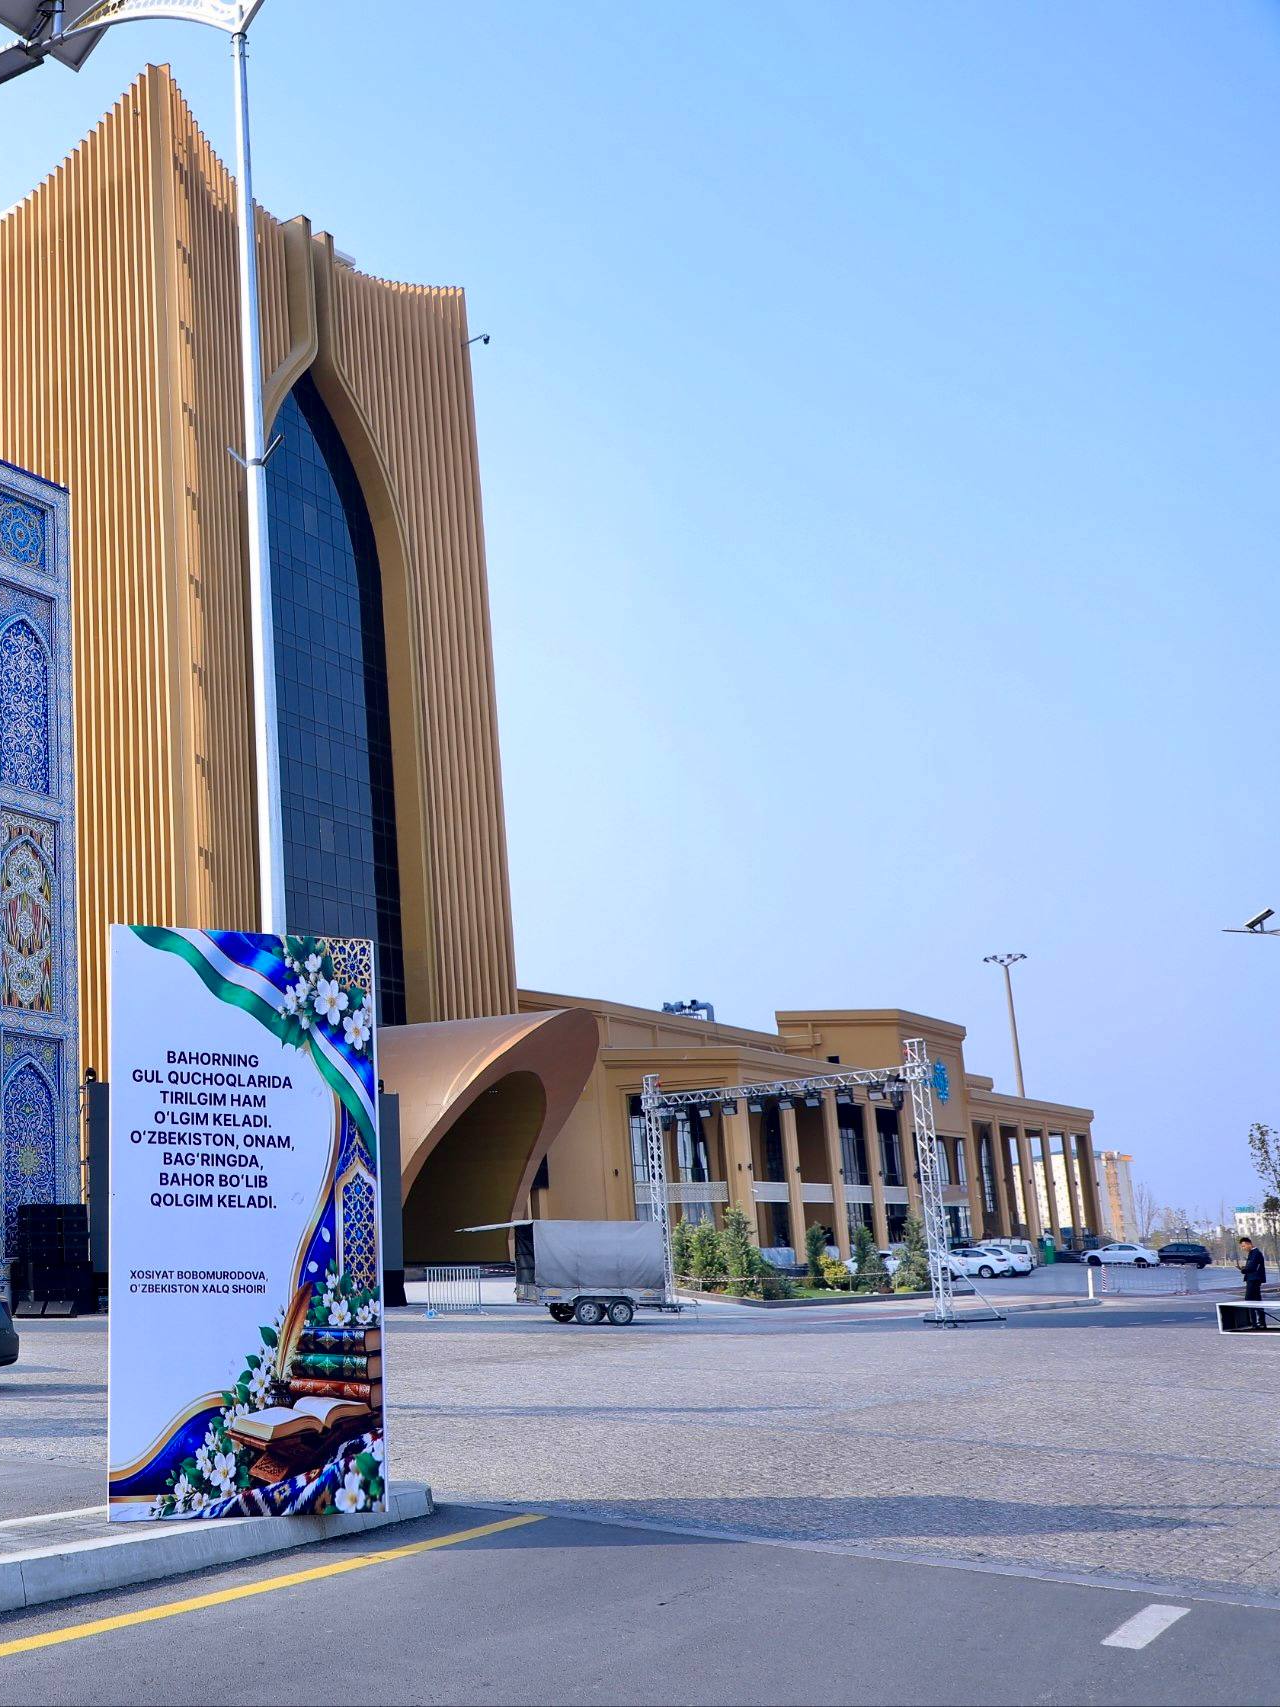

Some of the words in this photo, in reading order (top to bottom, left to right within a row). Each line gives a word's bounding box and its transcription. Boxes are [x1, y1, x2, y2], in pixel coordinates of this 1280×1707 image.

[167, 1050, 259, 1067] BAHORNING
[132, 1069, 163, 1083] GUL
[168, 1071, 293, 1089] QUCHOQLARIDA
[160, 1091, 227, 1106] TIRILGIM
[230, 1094, 266, 1108] HAM
[213, 1113, 272, 1128] KELADI.
[243, 1134, 295, 1151] ONAM,
[159, 1172, 214, 1187] BAHOR
[150, 1193, 213, 1208] QOLGIM
[217, 1195, 277, 1209] KELADI.
[130, 1270, 175, 1280] XOSIYAT
[177, 1270, 269, 1282] BOBOMURODOVA,
[202, 1284, 230, 1294] XALQ
[231, 1284, 266, 1294] SHOIRI
